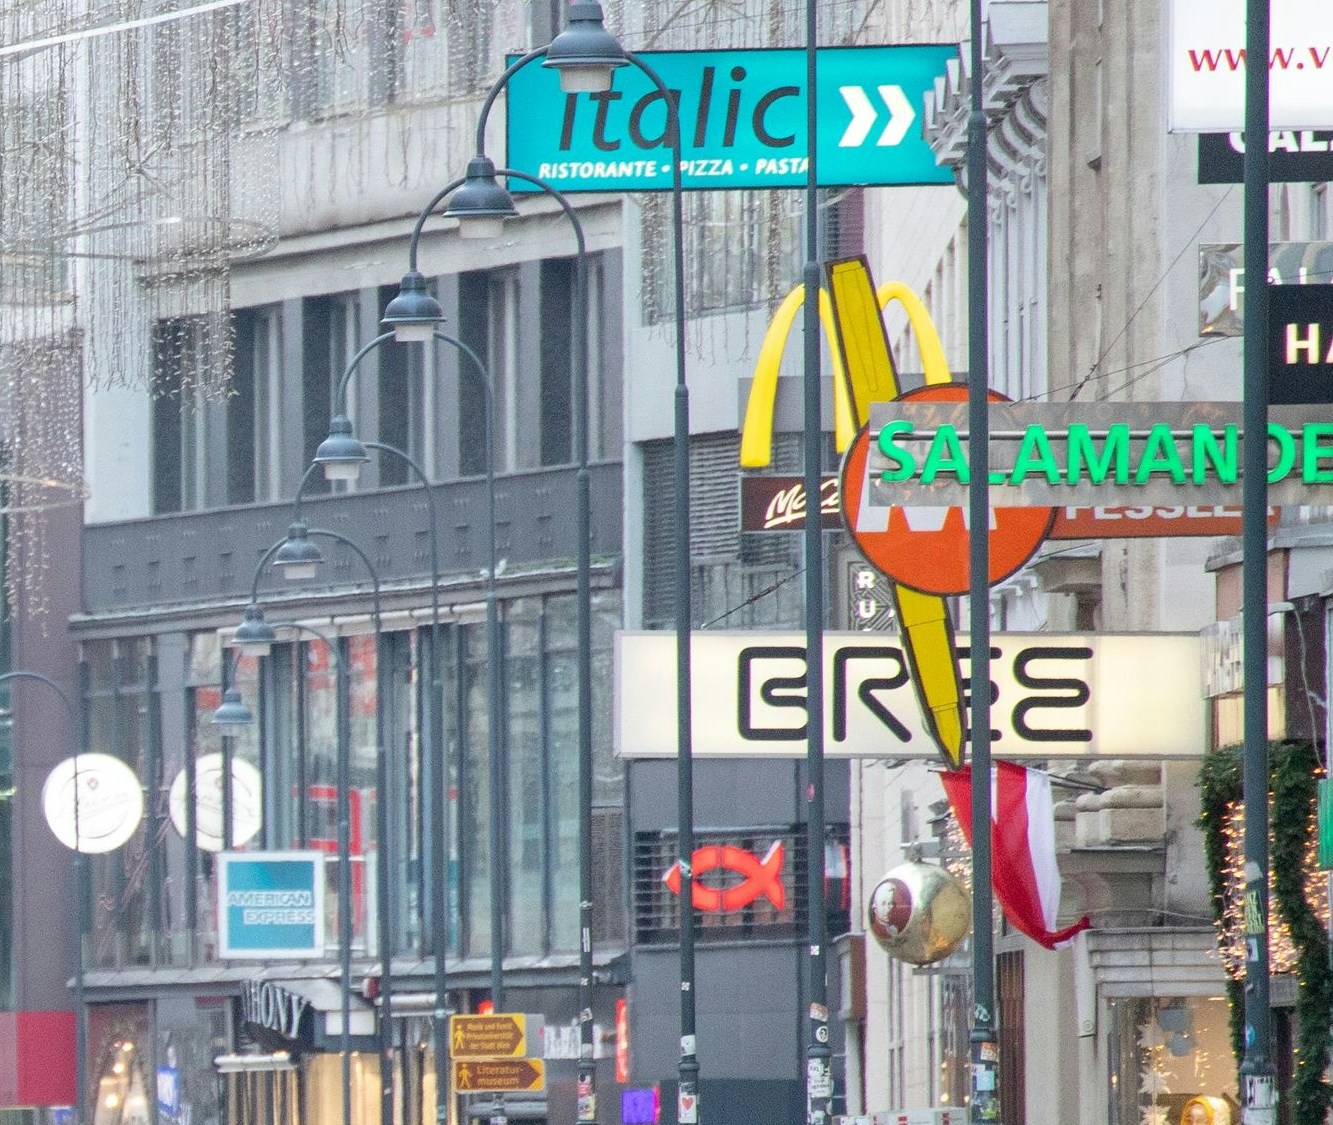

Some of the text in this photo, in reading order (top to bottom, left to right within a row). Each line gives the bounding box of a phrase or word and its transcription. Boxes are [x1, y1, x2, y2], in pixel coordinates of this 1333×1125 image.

[559, 65, 801, 152] italic
[539, 157, 810, 179] RISTORANTE PIZZA PASTA
[878, 419, 1333, 487] SAAMANDE
[227, 891, 312, 907] AMERICAN
[244, 910, 315, 925] EXPRESS
